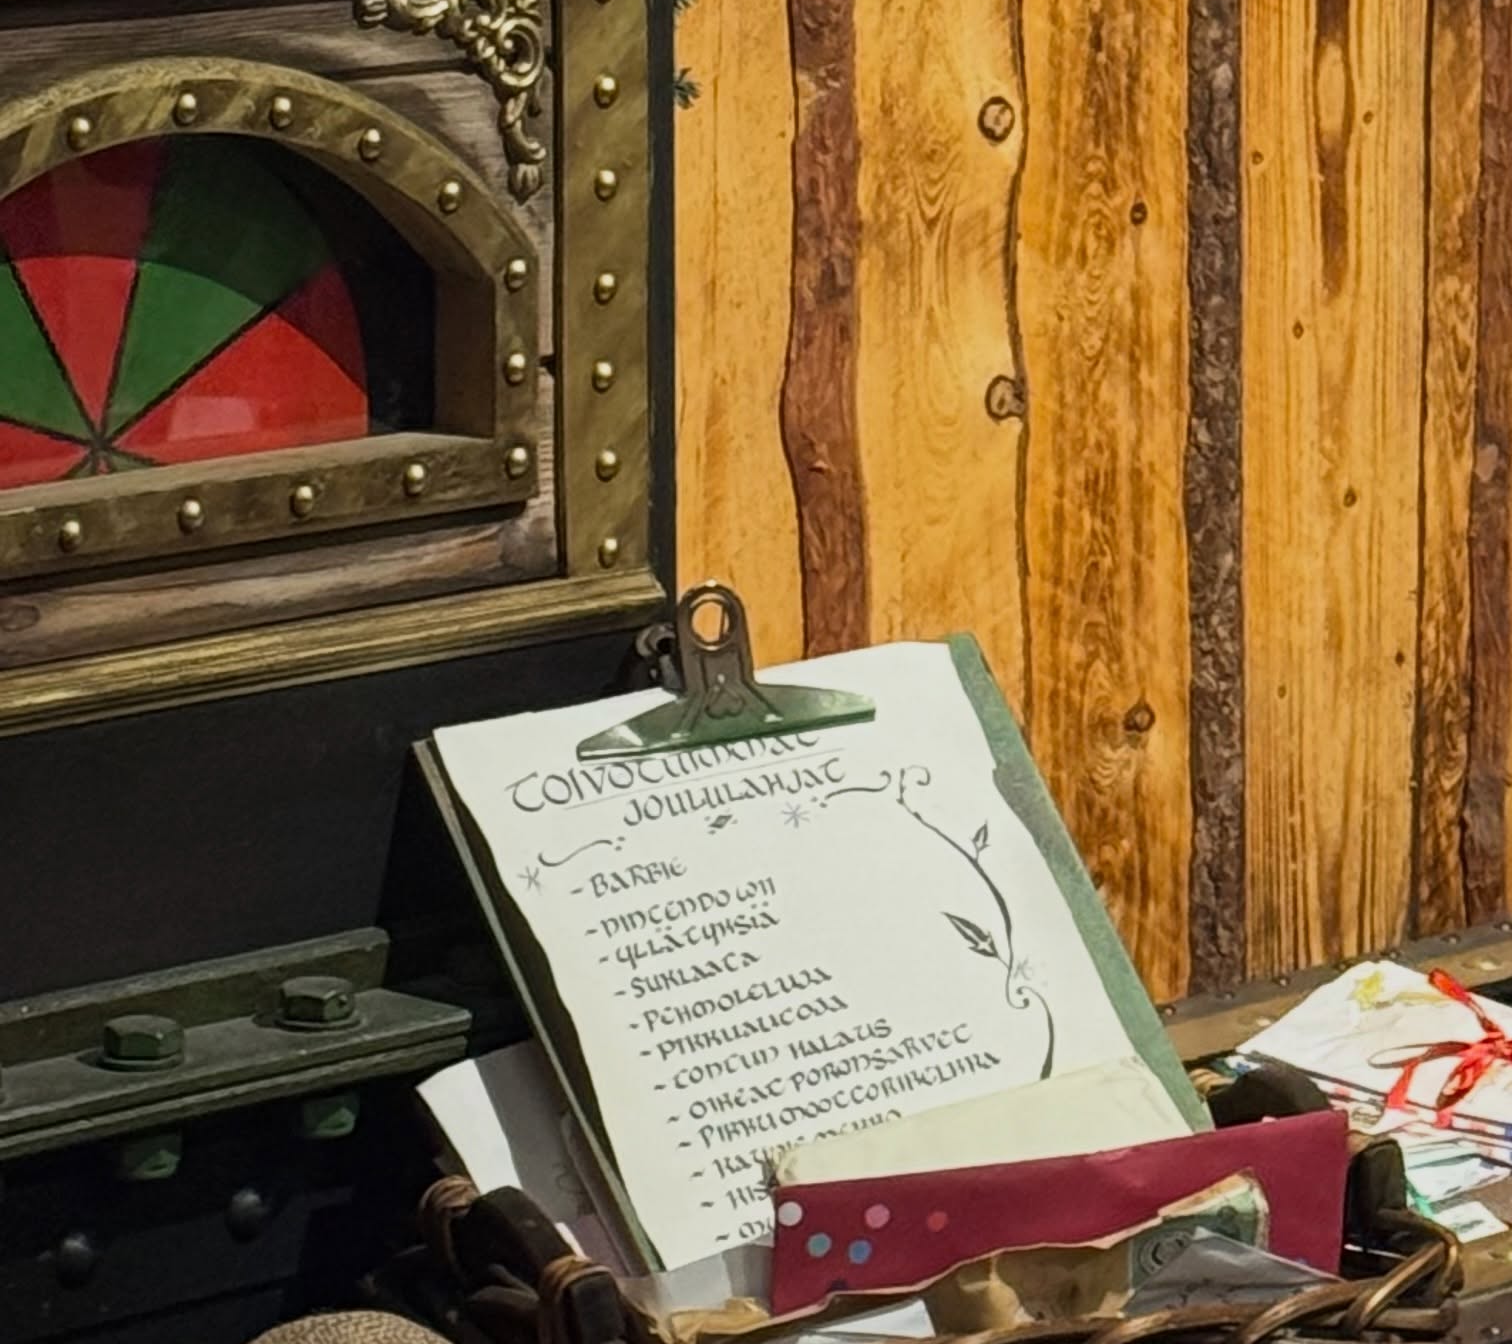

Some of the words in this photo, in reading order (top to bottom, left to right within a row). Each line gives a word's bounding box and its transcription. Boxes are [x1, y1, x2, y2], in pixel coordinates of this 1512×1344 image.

[623, 757, 846, 826] JOULULAHJAT
[590, 857, 687, 898] BARBIE
[630, 951, 762, 999] SUKLAATA
